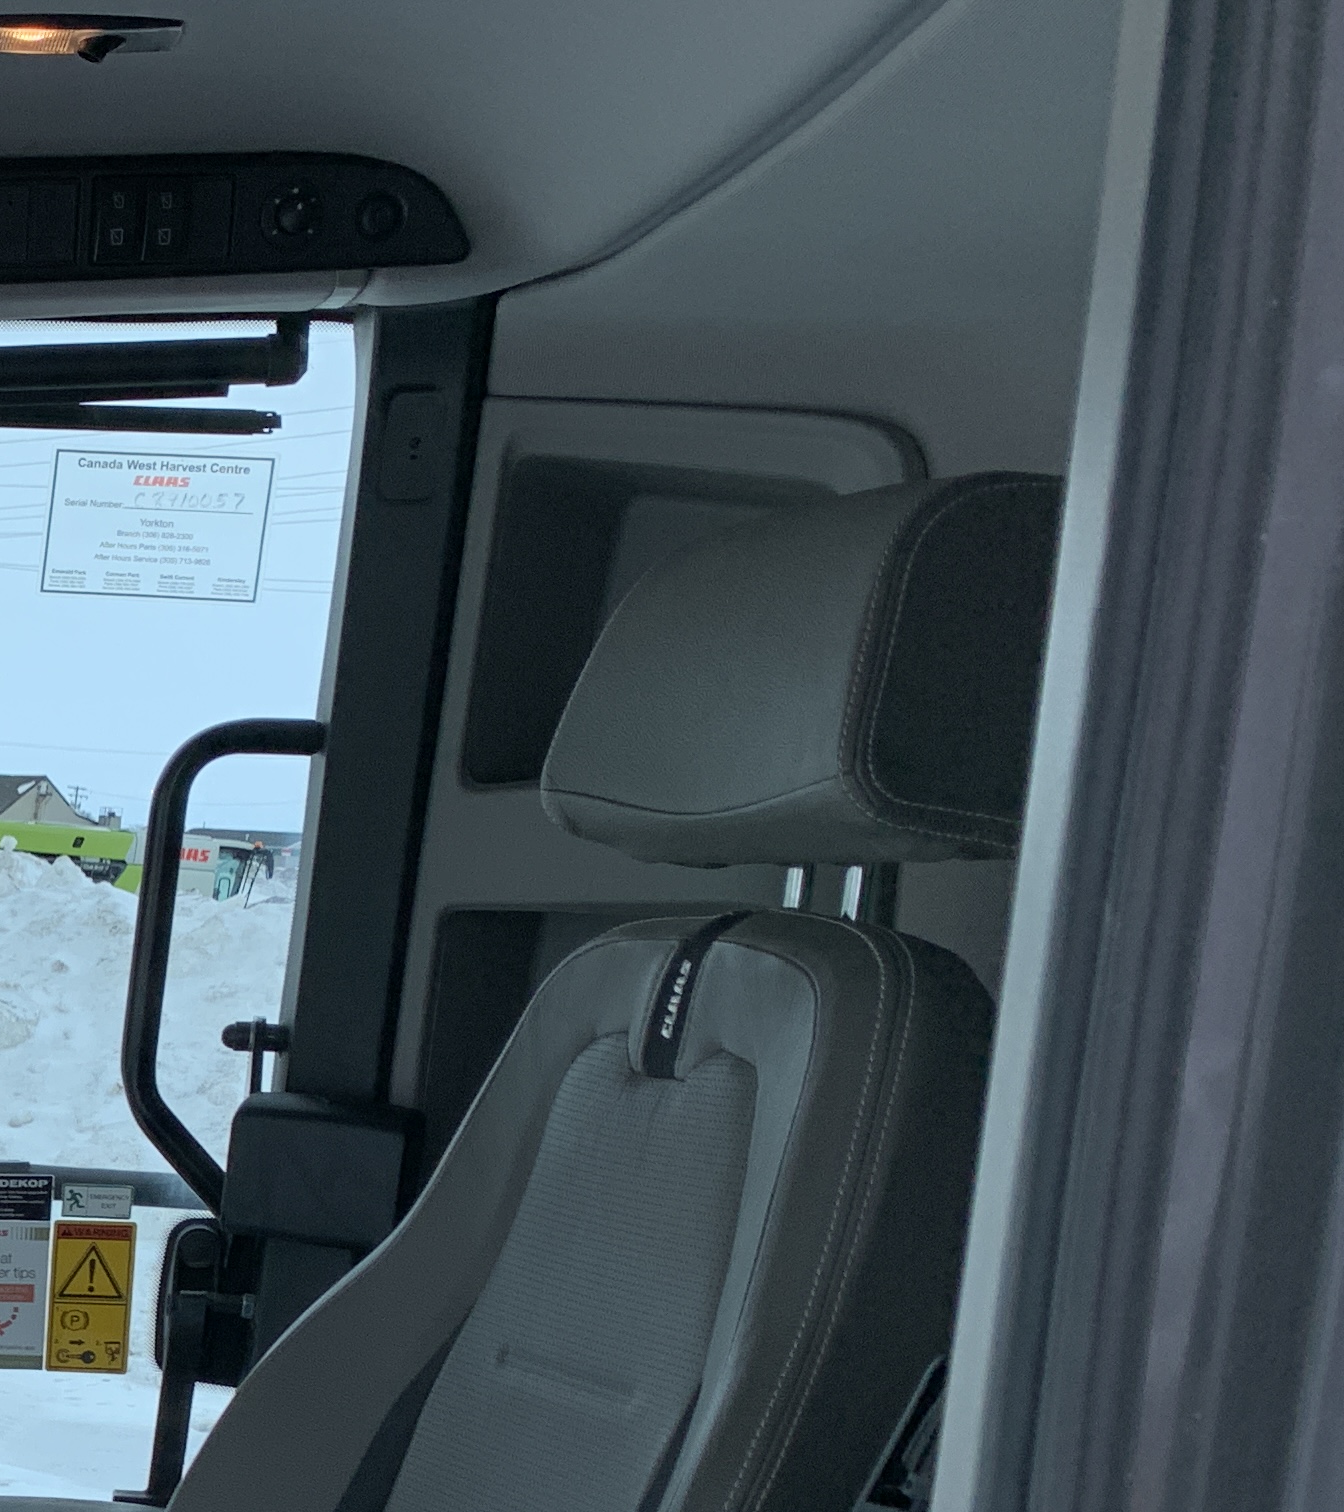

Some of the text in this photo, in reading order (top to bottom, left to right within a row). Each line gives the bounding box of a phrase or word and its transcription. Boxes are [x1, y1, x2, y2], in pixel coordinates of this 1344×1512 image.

[78, 457, 251, 475] Canada West Harvest Centre
[133, 475, 191, 488] CLAAS
[64, 498, 88, 507] Serial
[139, 518, 174, 528] Yorkton
[660, 958, 692, 1040] CLAAS
[100, 1202, 117, 1210] EXIT
[74, 1227, 130, 1238] WARNING
[0, 1252, 13, 1264] at
[13, 1267, 36, 1280] tips
